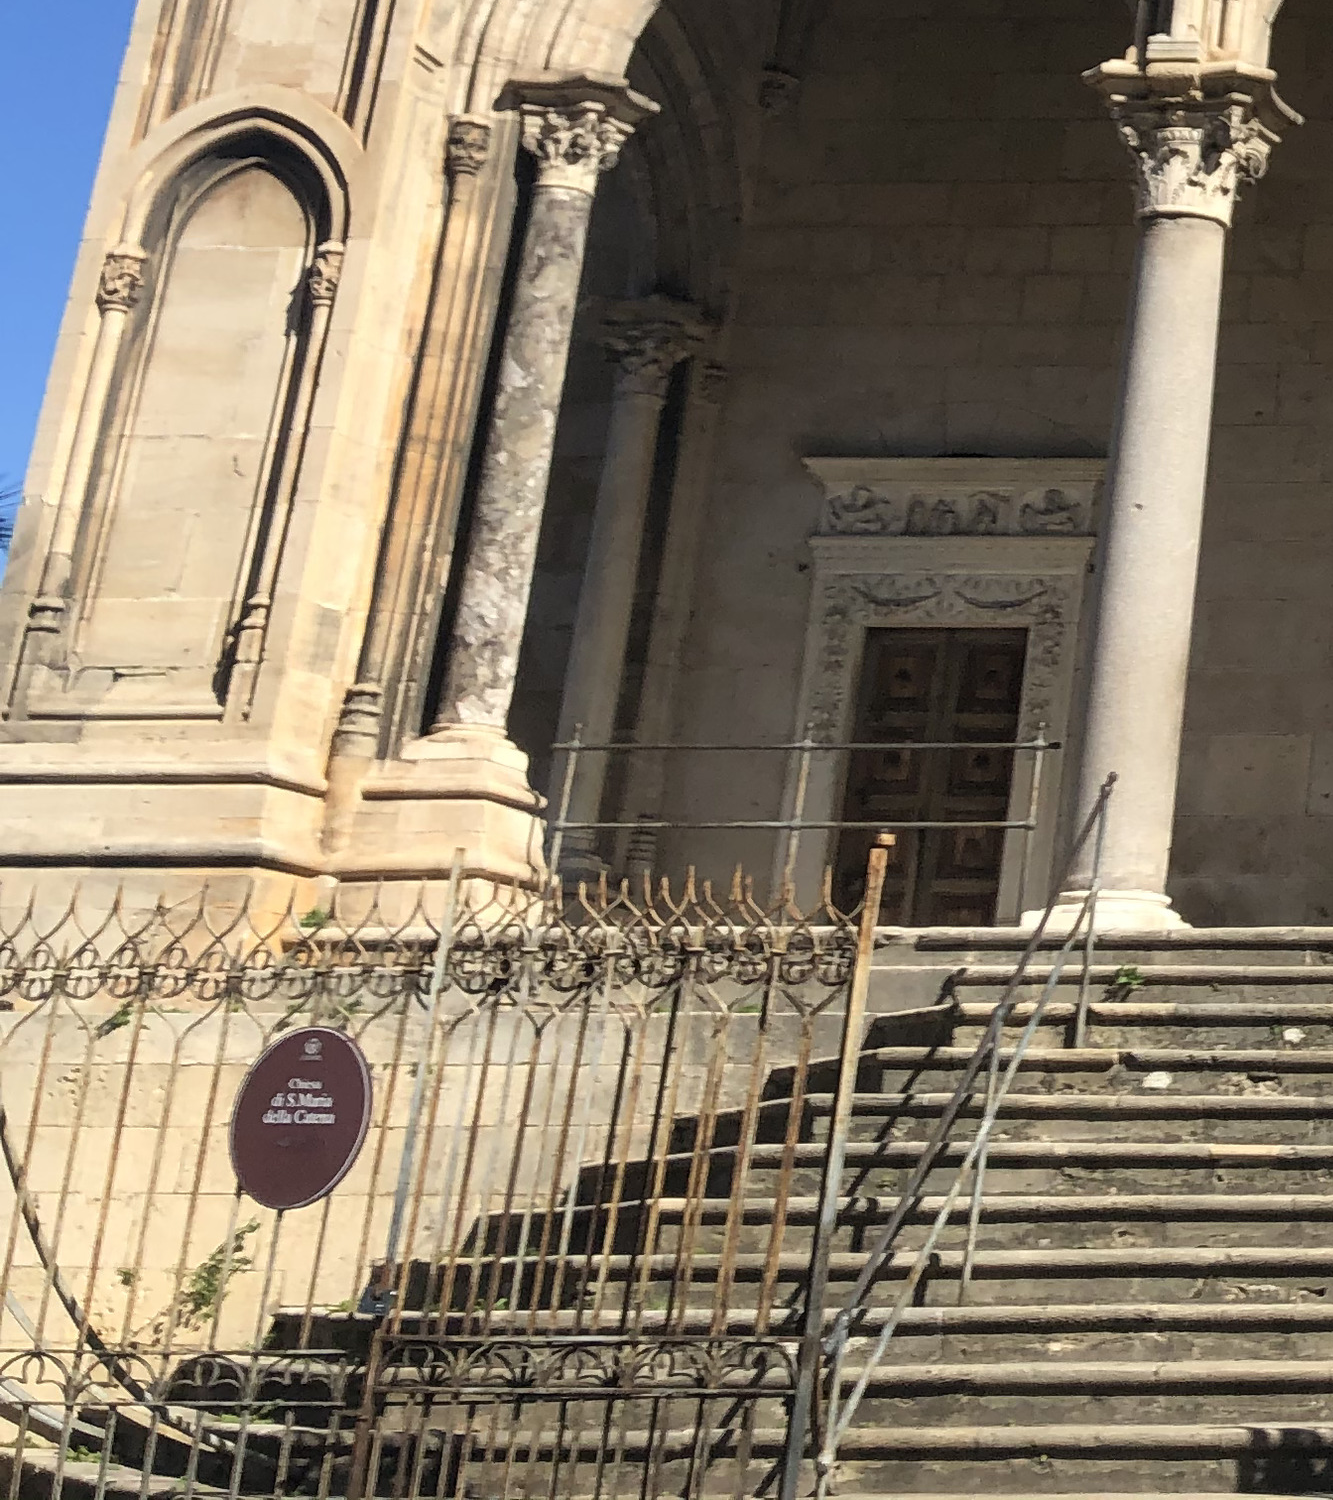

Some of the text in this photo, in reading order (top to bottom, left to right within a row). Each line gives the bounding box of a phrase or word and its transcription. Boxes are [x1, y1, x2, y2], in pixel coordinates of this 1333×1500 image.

[270, 1092, 285, 1107] di
[262, 1109, 336, 1124] della Catena
